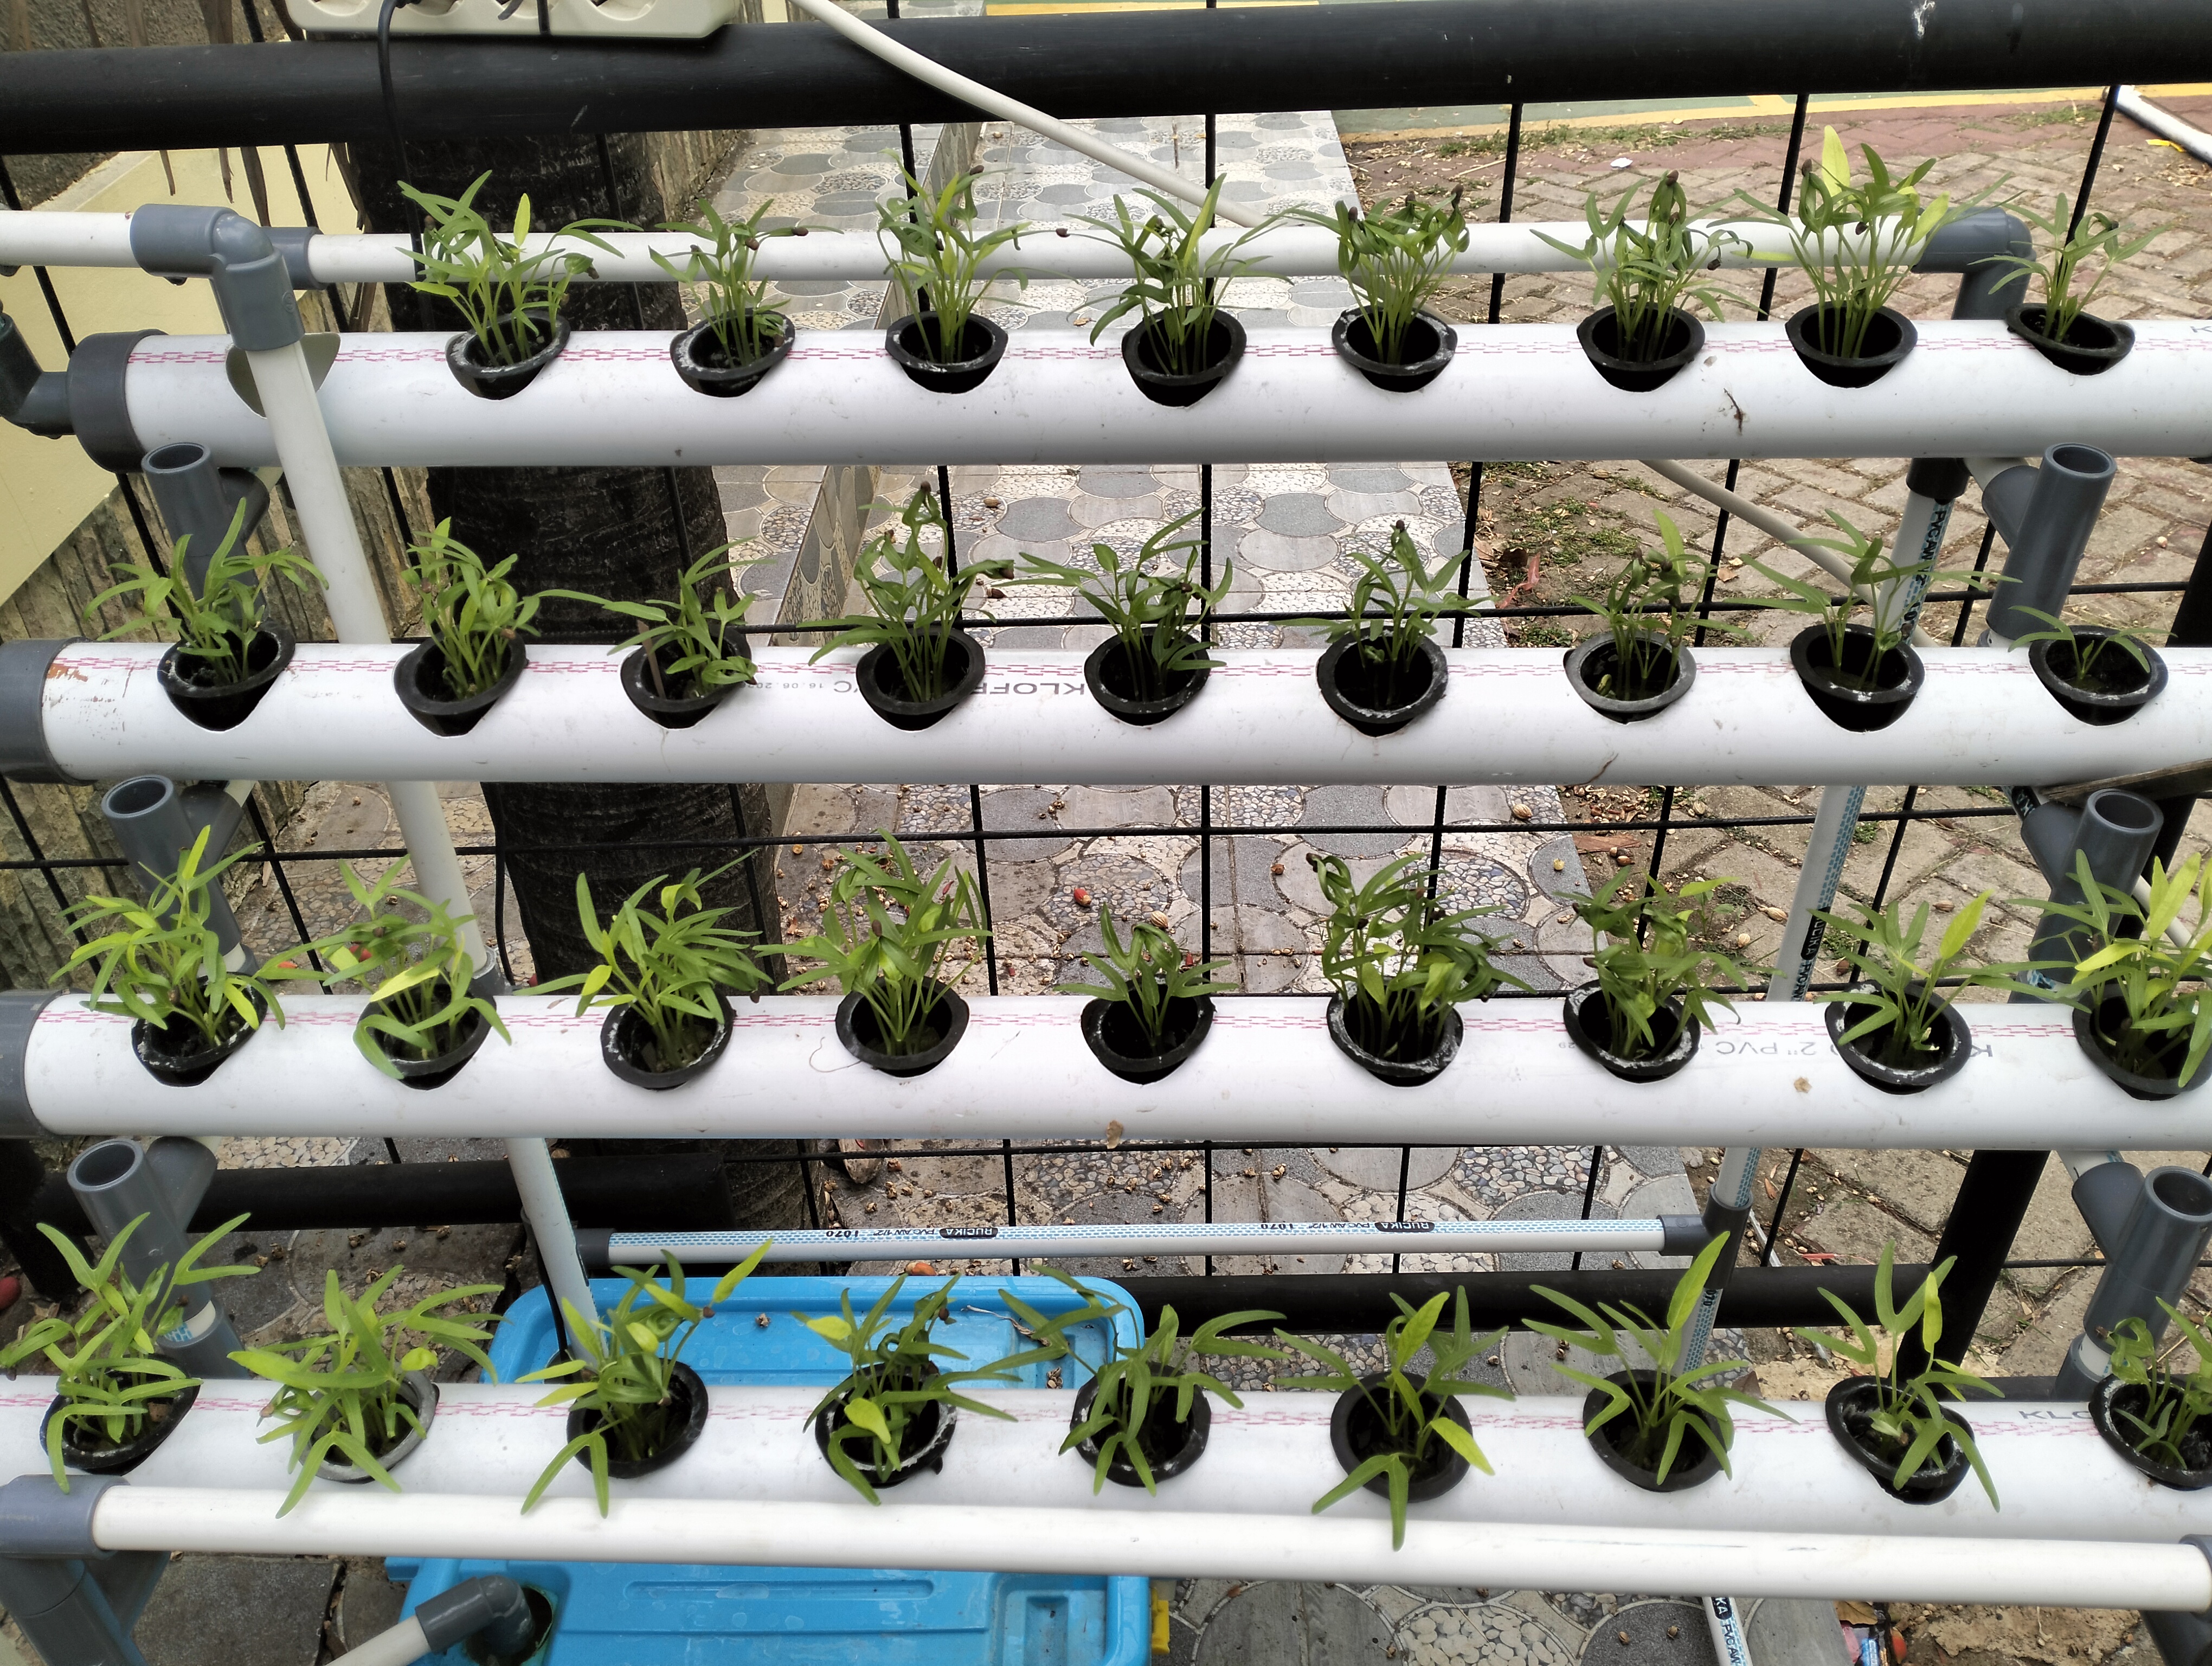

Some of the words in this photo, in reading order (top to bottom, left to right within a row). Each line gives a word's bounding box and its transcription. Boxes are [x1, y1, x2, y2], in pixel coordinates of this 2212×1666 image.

[1806, 918, 1825, 956] UCIKA
[1715, 1041, 1778, 1055] PVC
[1787, 1041, 1817, 1056] 2"
[826, 1230, 859, 1238] 1070
[945, 1228, 993, 1236] RUCIKA
